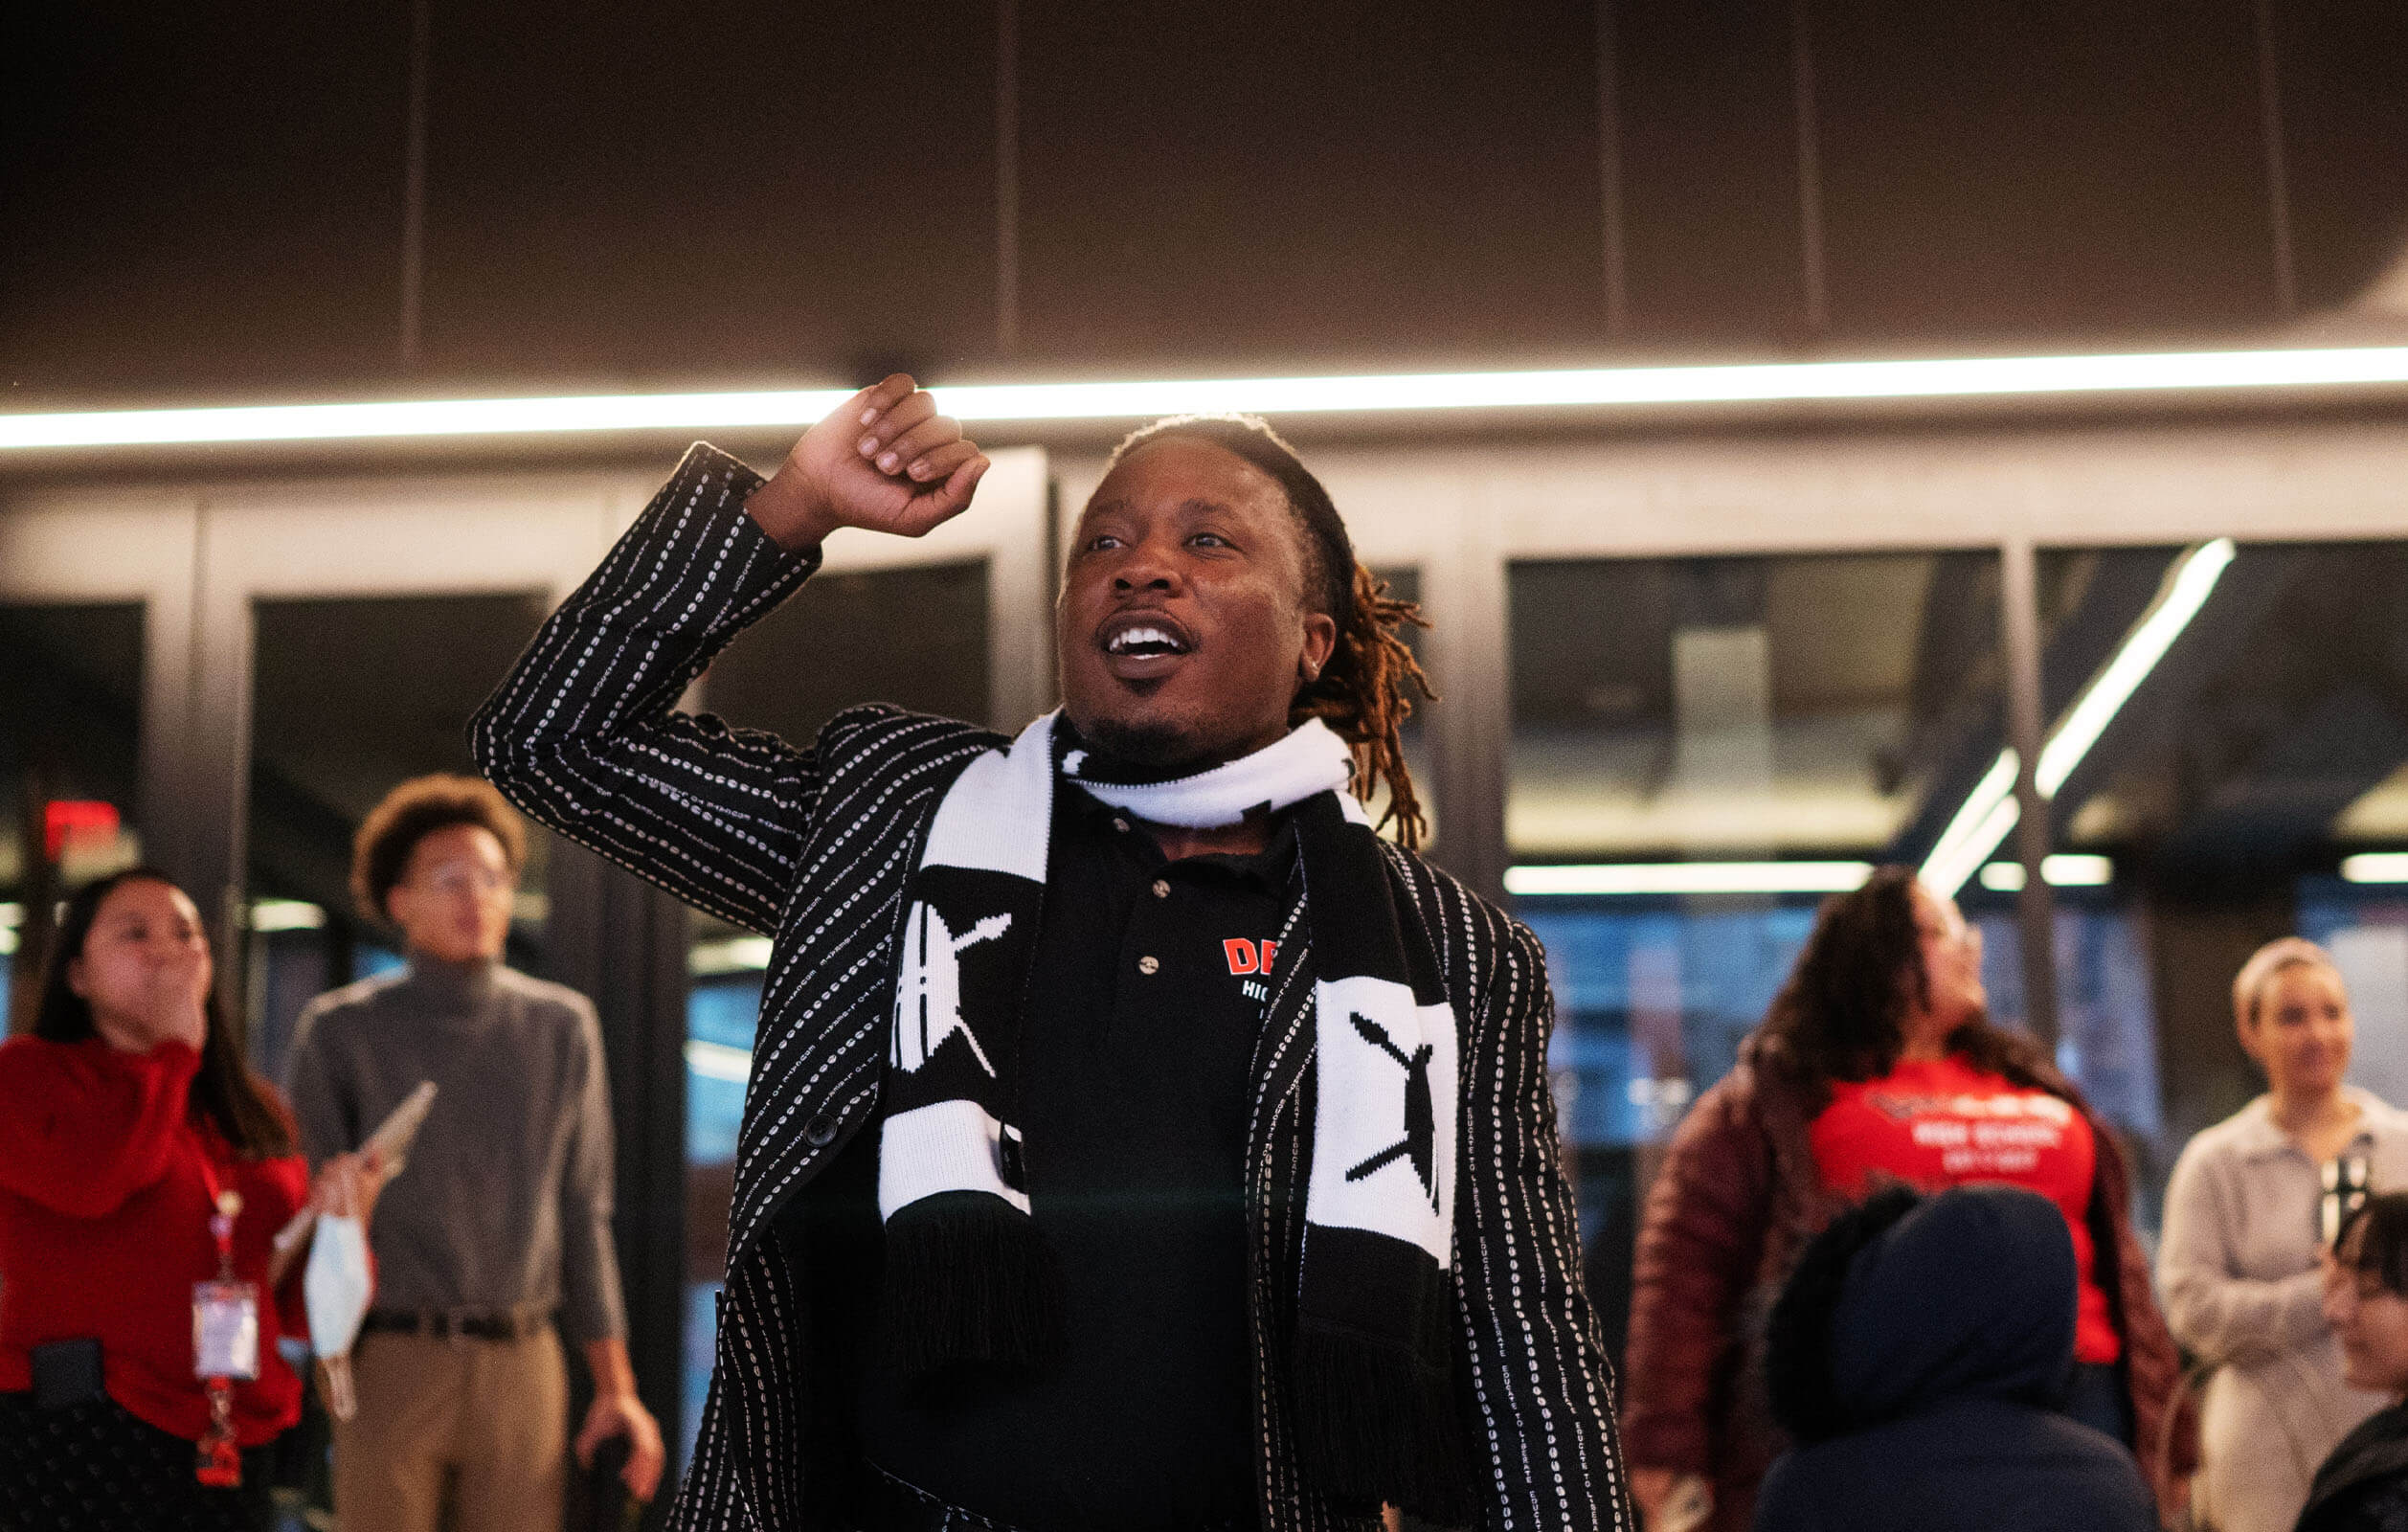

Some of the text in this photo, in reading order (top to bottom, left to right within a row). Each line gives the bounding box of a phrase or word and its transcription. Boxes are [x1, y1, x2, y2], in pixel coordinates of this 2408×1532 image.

[858, 992, 869, 1003] TO
[773, 1085, 783, 1096] TO
[1470, 1157, 1475, 1171] TO
[1479, 1236, 1491, 1284] EDUCATE
[1487, 1287, 1494, 1300] TO
[1502, 1365, 1518, 1409] EDUCATE
[1516, 1412, 1524, 1427] TO
[1519, 1431, 1532, 1483] LIBERATE
[1575, 1422, 1587, 1470] EDUCATE
[1584, 1474, 1590, 1487] TO
